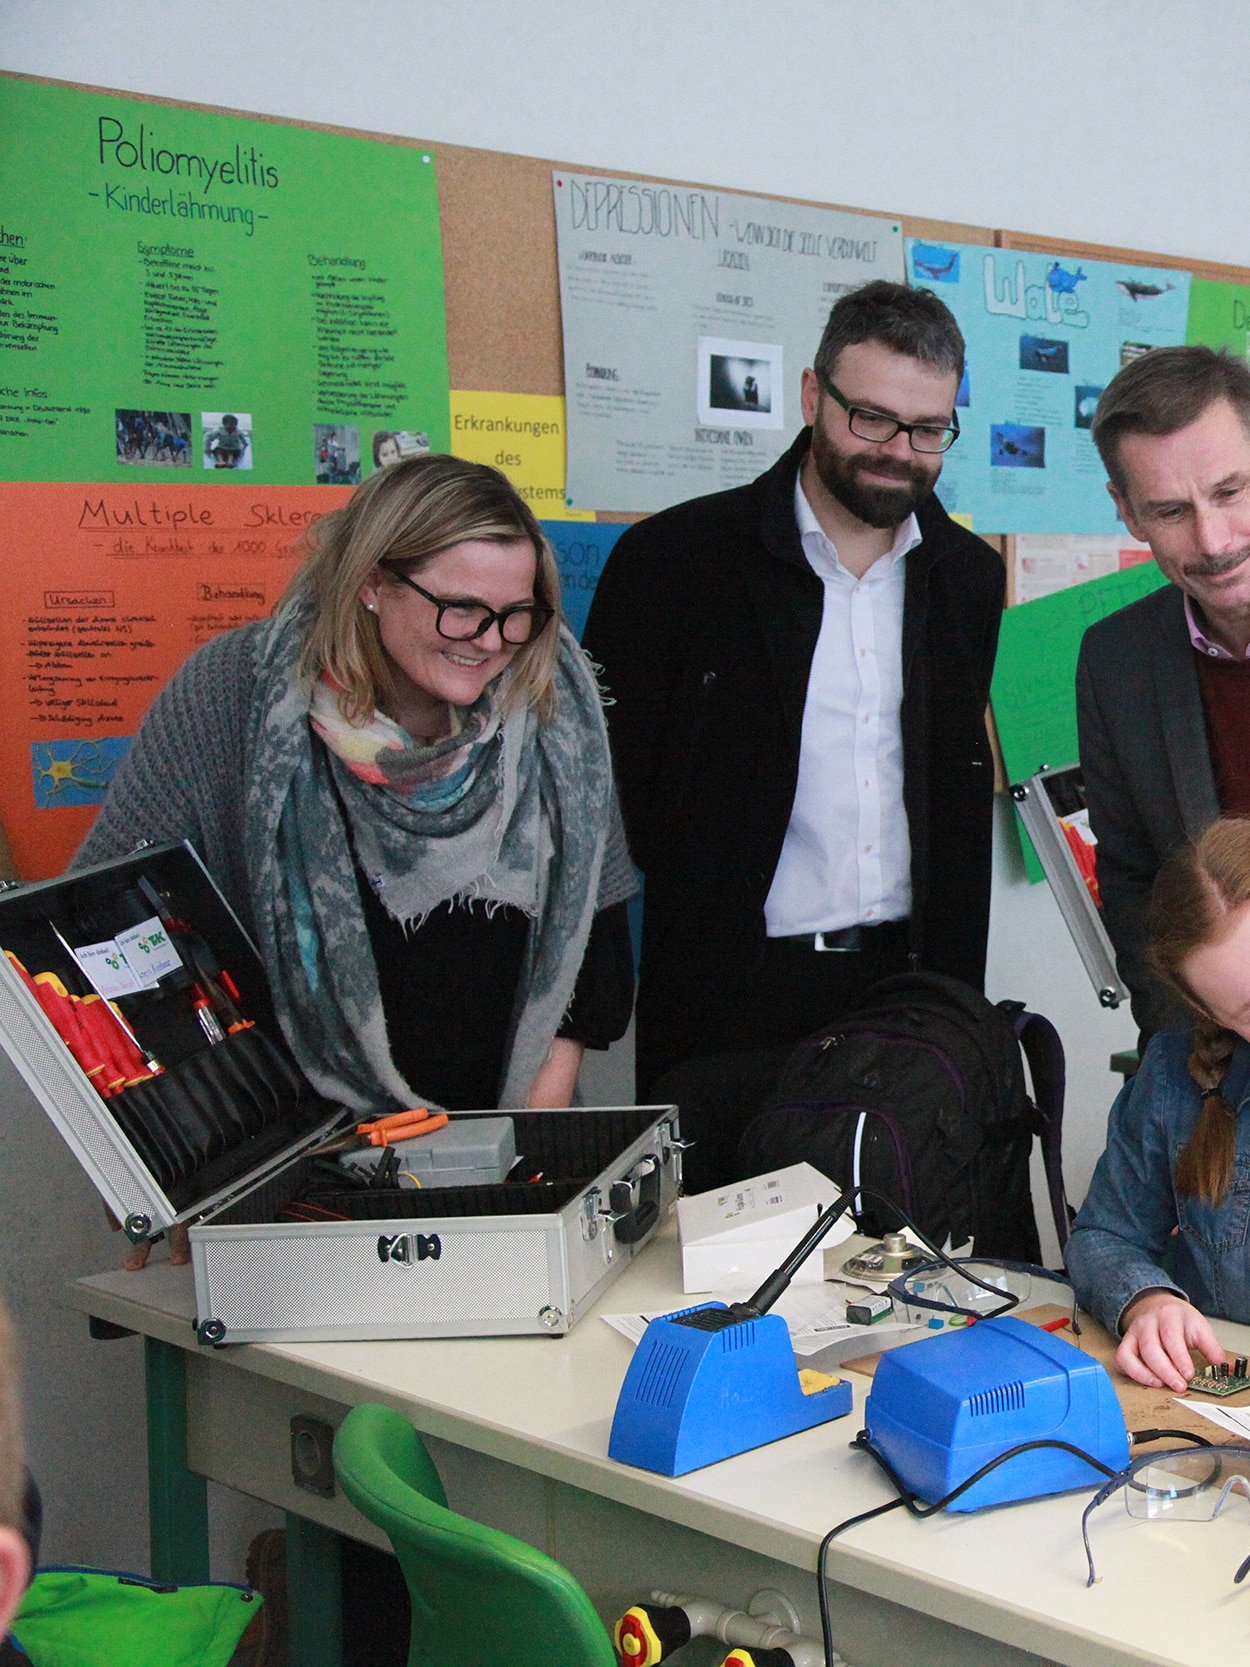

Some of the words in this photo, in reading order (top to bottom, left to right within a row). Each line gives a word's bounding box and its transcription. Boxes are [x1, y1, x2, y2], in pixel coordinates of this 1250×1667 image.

[98, 115, 280, 193] Poliomyelitis
[570, 179, 720, 242] DEPRESSIONEN
[137, 240, 195, 257] Symptome
[307, 253, 367, 271] Behandlung
[983, 254, 1090, 329] Wale
[454, 415, 560, 437] Erkrankungen
[495, 451, 522, 466] des
[78, 499, 215, 530] Multiple
[49, 594, 107, 605] Ursachen
[200, 584, 266, 606] Behandlung
